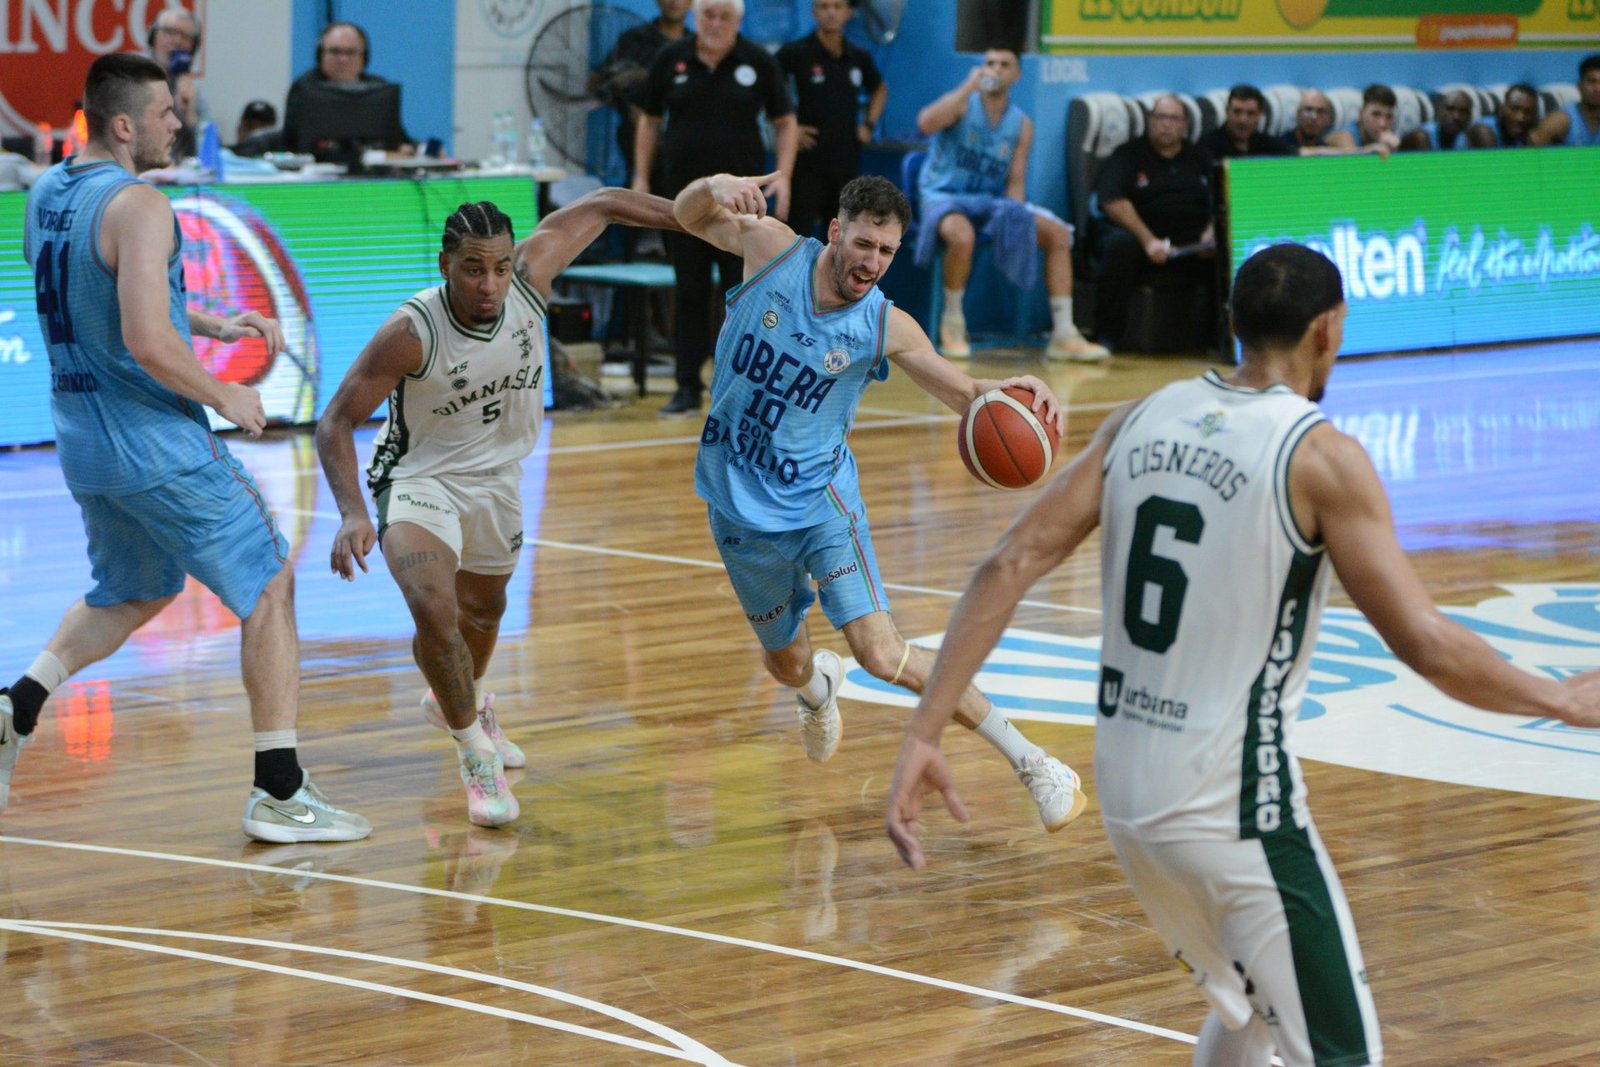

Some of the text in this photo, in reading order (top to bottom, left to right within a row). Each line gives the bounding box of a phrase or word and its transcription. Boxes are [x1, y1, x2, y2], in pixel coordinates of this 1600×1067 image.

[35, 240, 76, 346] 41
[731, 333, 838, 414] OBERA
[482, 400, 501, 424] 5
[738, 417, 773, 446] DON
[743, 388, 787, 433] 10
[701, 414, 799, 485] BASILIO
[1128, 440, 1248, 502] CISNEROS
[1124, 494, 1205, 654] 6
